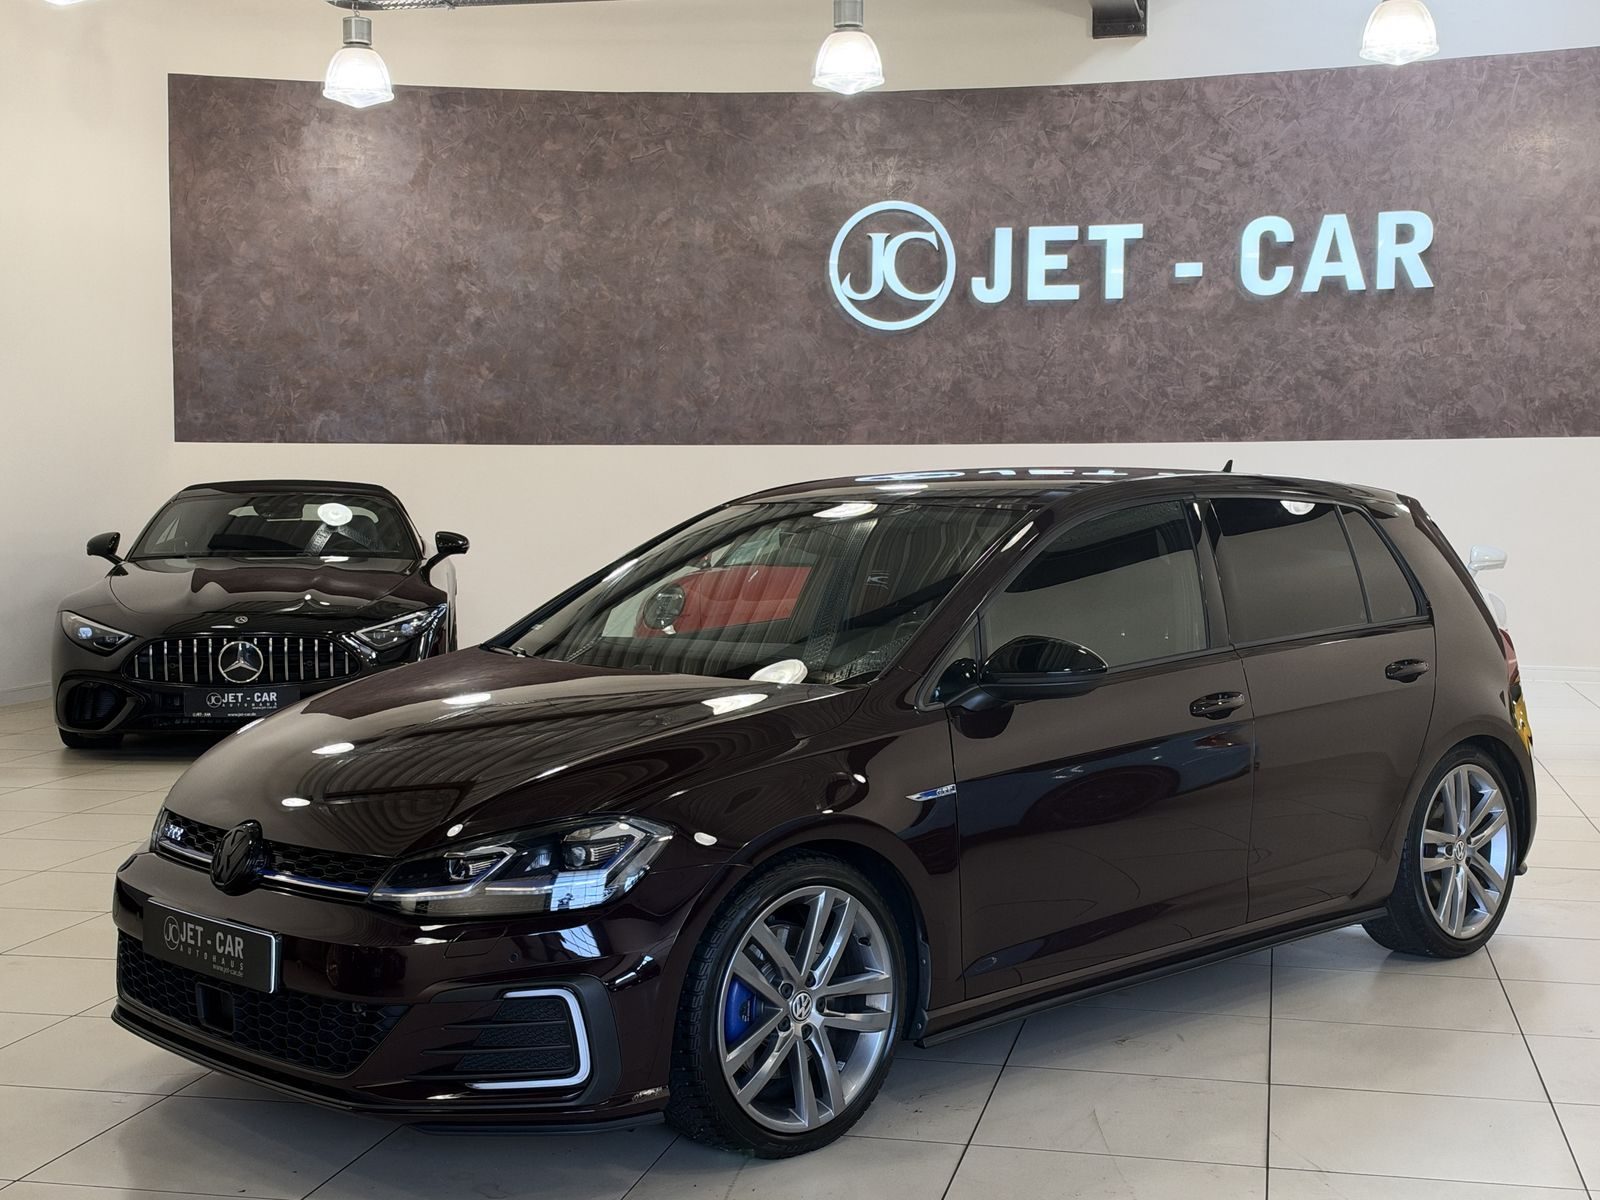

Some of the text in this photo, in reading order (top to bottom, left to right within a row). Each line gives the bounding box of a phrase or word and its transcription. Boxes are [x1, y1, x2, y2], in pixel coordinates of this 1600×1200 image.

[971, 223, 1144, 303] JET
[1240, 210, 1435, 296] CAR
[222, 693, 244, 703] JET
[254, 692, 277, 702] CAR
[180, 921, 204, 947] JET
[215, 931, 244, 959] CAR
[179, 944, 244, 971] AUTOHAUS
